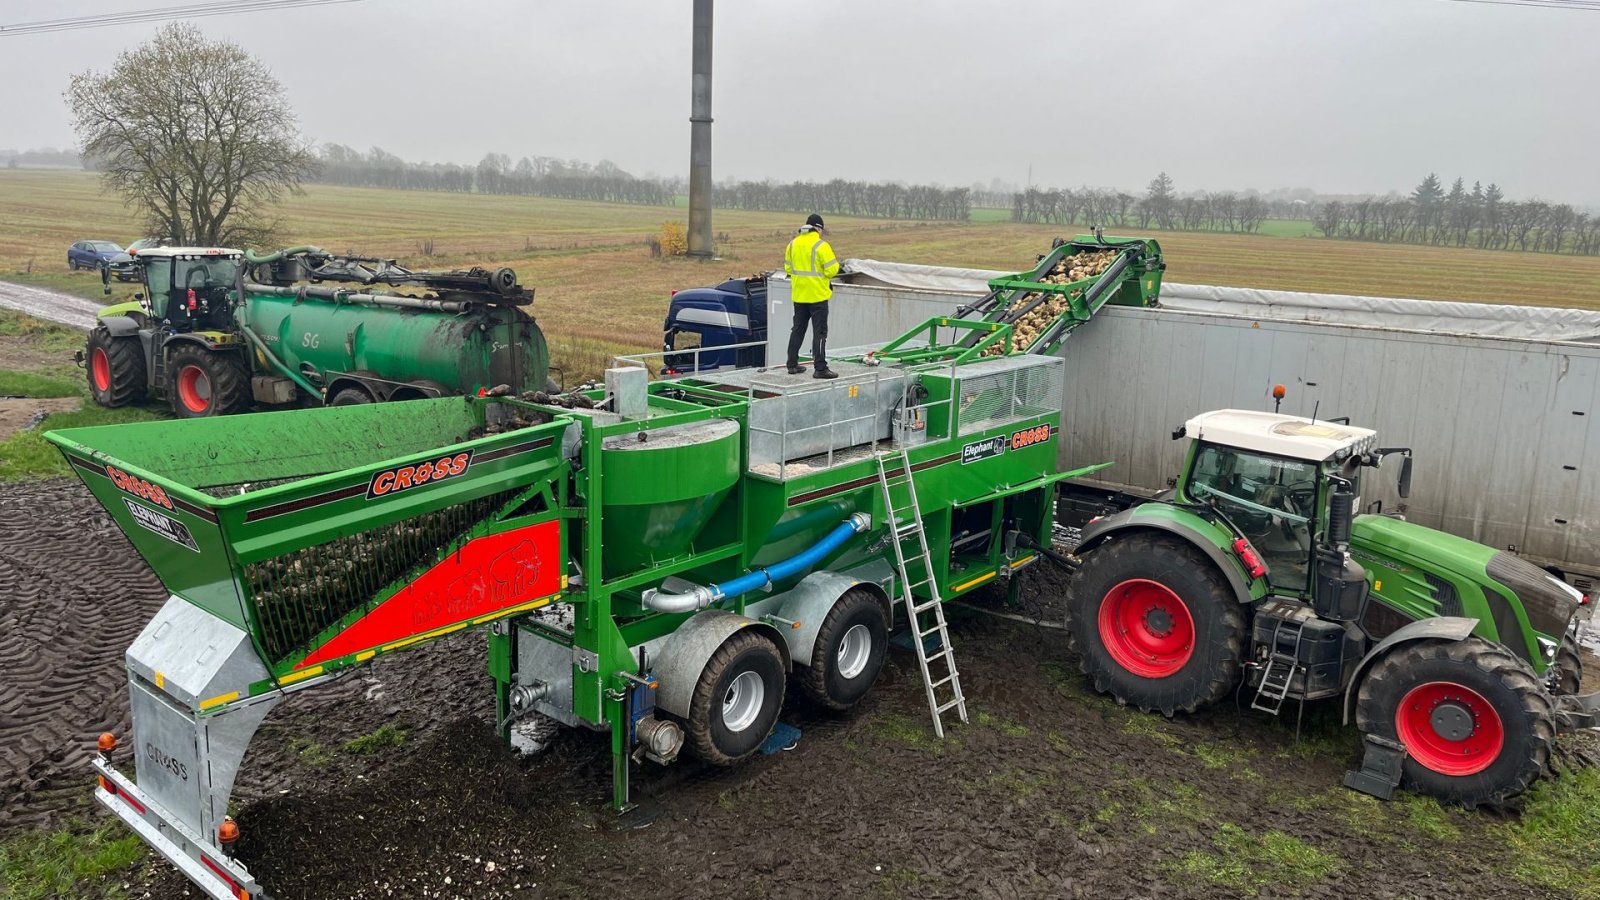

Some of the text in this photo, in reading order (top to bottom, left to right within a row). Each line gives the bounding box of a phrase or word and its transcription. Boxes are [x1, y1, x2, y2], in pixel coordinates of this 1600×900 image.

[964, 440, 994, 457] Elephant
[1012, 425, 1049, 449] CROSS
[106, 465, 173, 510] CROSS
[373, 452, 469, 495] CROSS
[127, 501, 173, 533] ELEPHANT
[146, 742, 188, 781] CROSS
